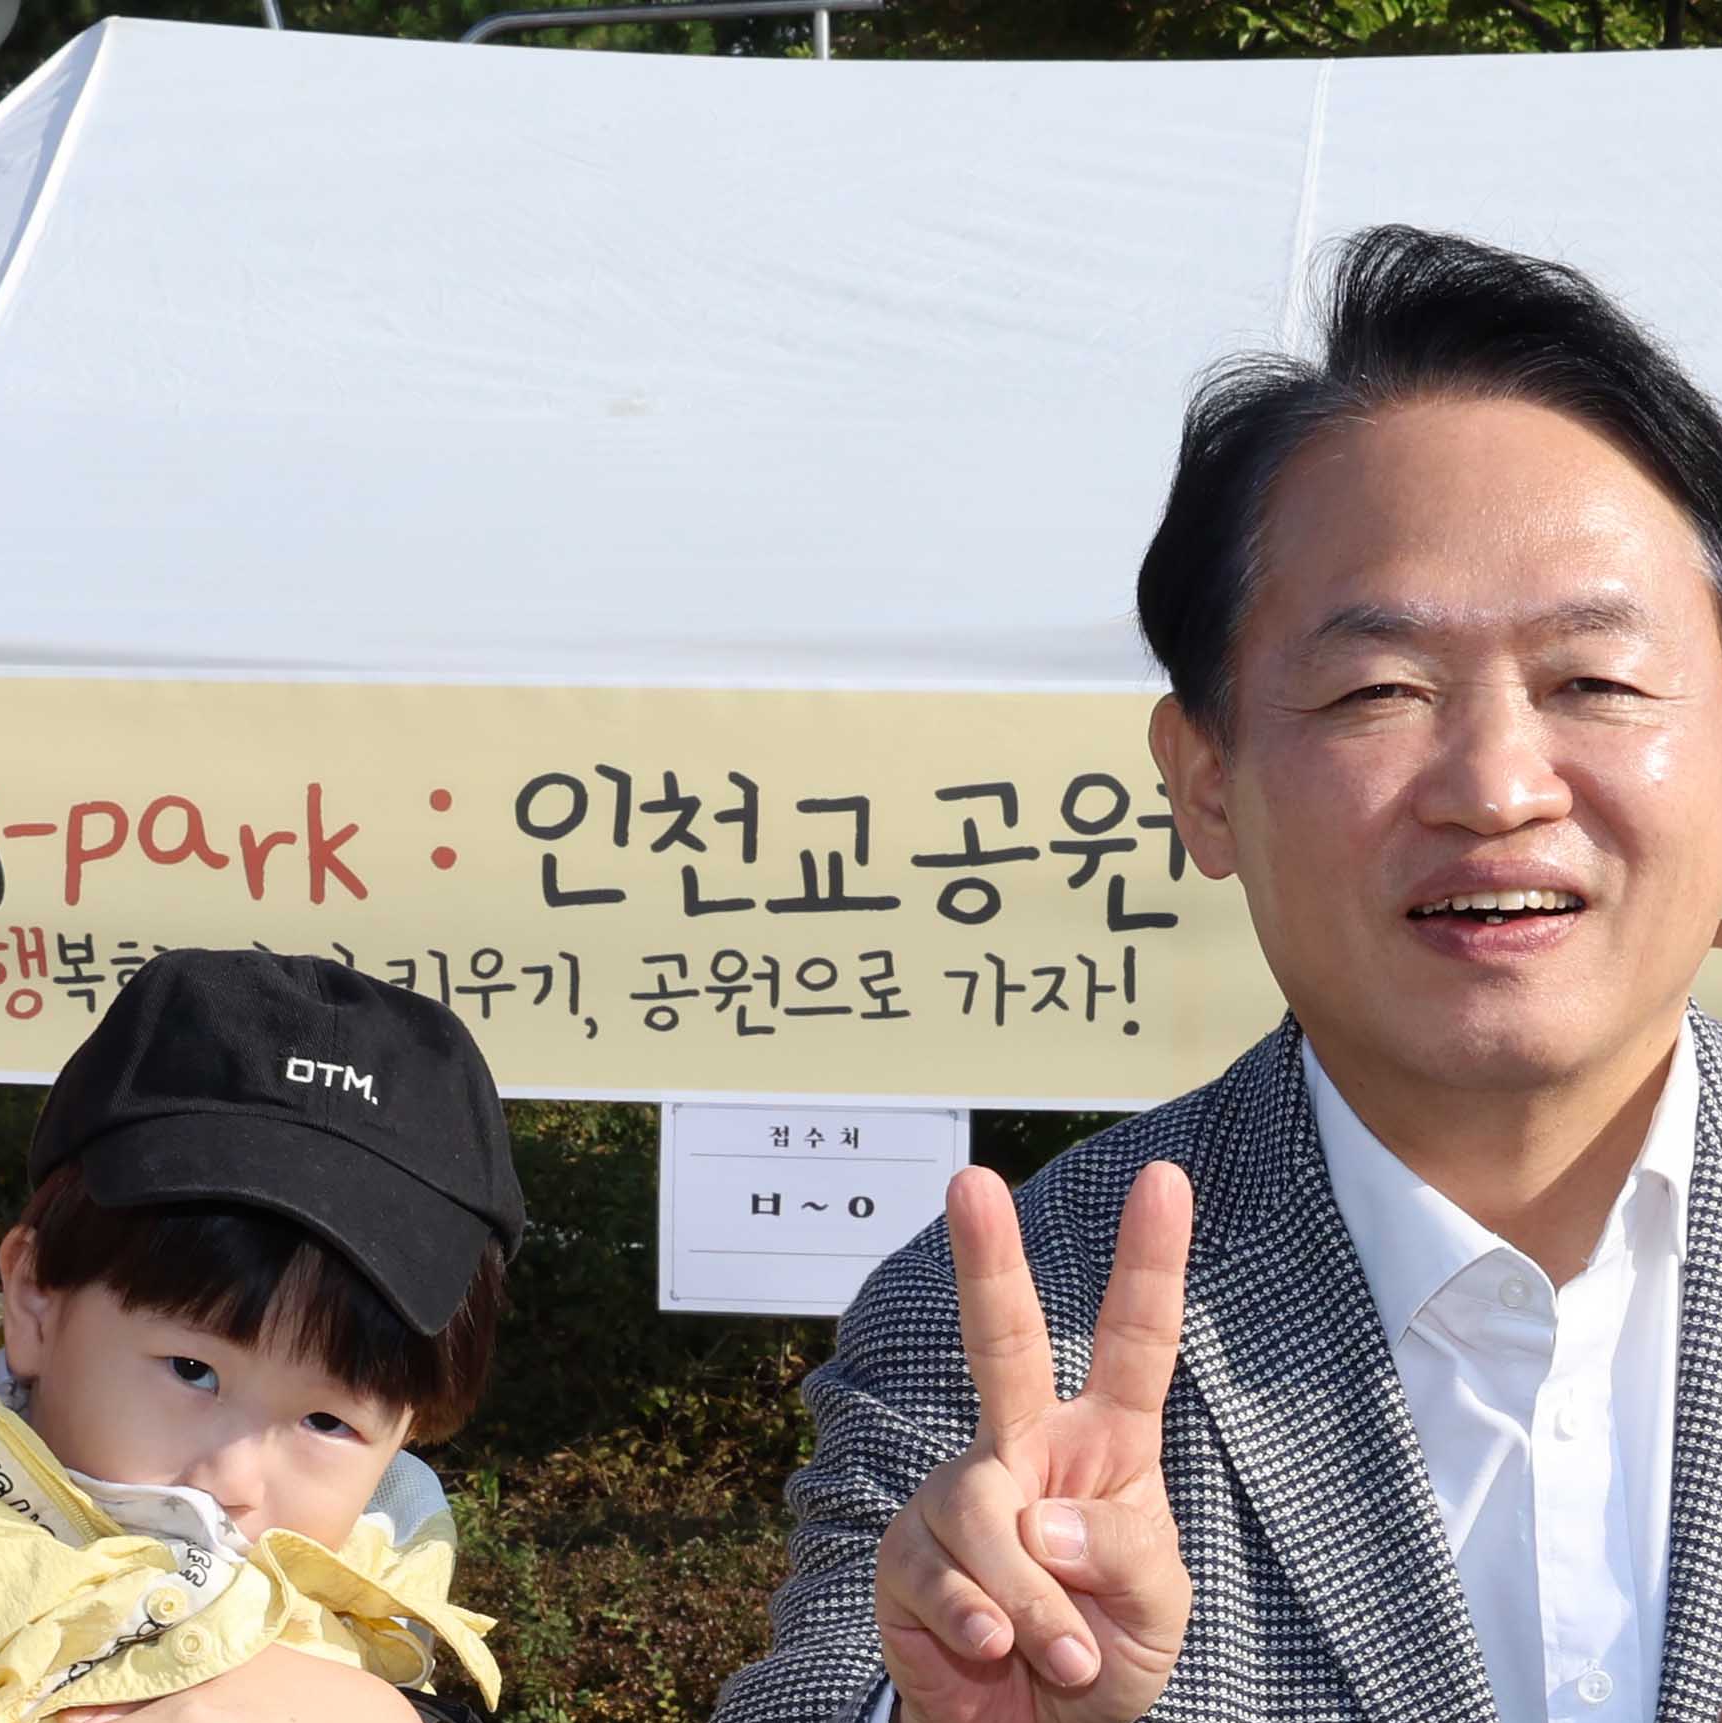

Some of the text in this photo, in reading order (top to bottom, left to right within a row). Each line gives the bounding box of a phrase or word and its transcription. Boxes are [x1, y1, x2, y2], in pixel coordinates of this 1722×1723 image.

[630, 949, 911, 1037] 공원으로
[945, 945, 1140, 1036] 가자!
[285, 1057, 379, 1106] OTM.
